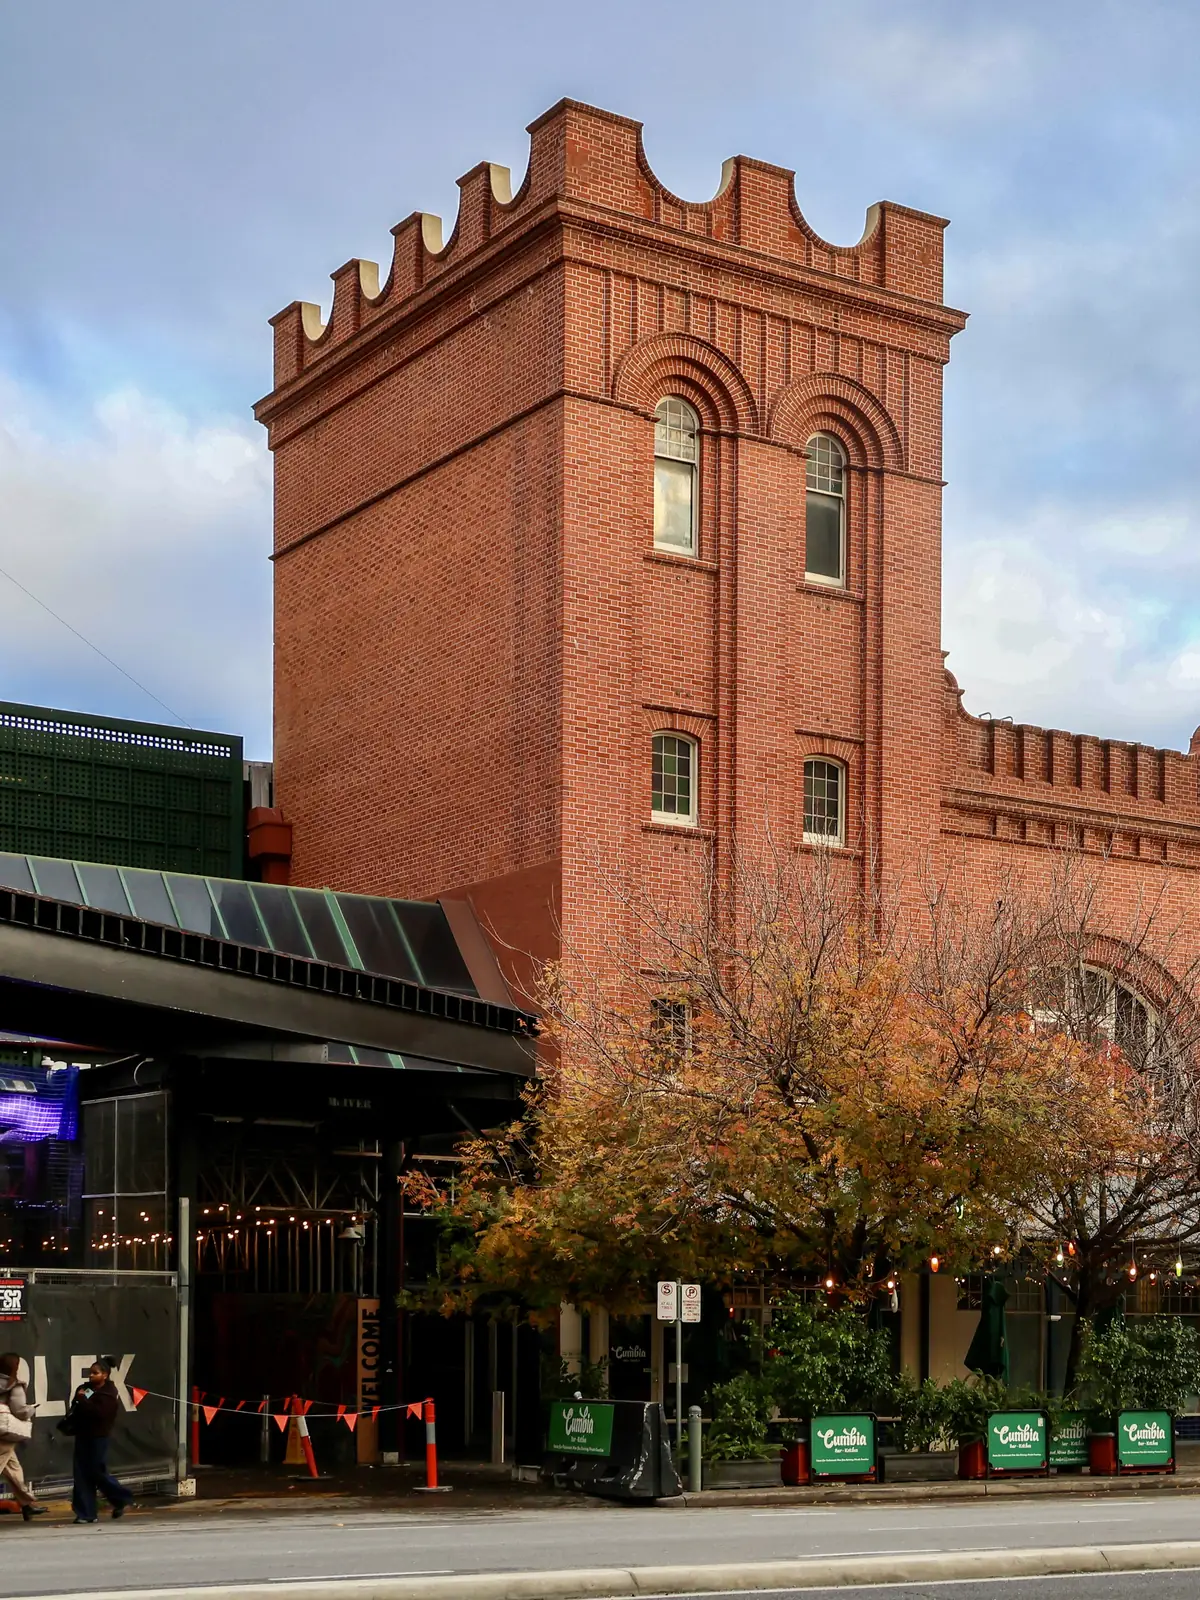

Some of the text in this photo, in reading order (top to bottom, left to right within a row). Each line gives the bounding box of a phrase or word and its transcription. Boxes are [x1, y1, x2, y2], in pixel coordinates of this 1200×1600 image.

[610, 1344, 647, 1359] Cumbia
[361, 1308, 380, 1419] WELCOME
[562, 1405, 594, 1436] Cumbia
[1122, 1421, 1166, 1442] Cumbia
[816, 1426, 867, 1449] Cumbia
[993, 1423, 1040, 1445] Cumbia
